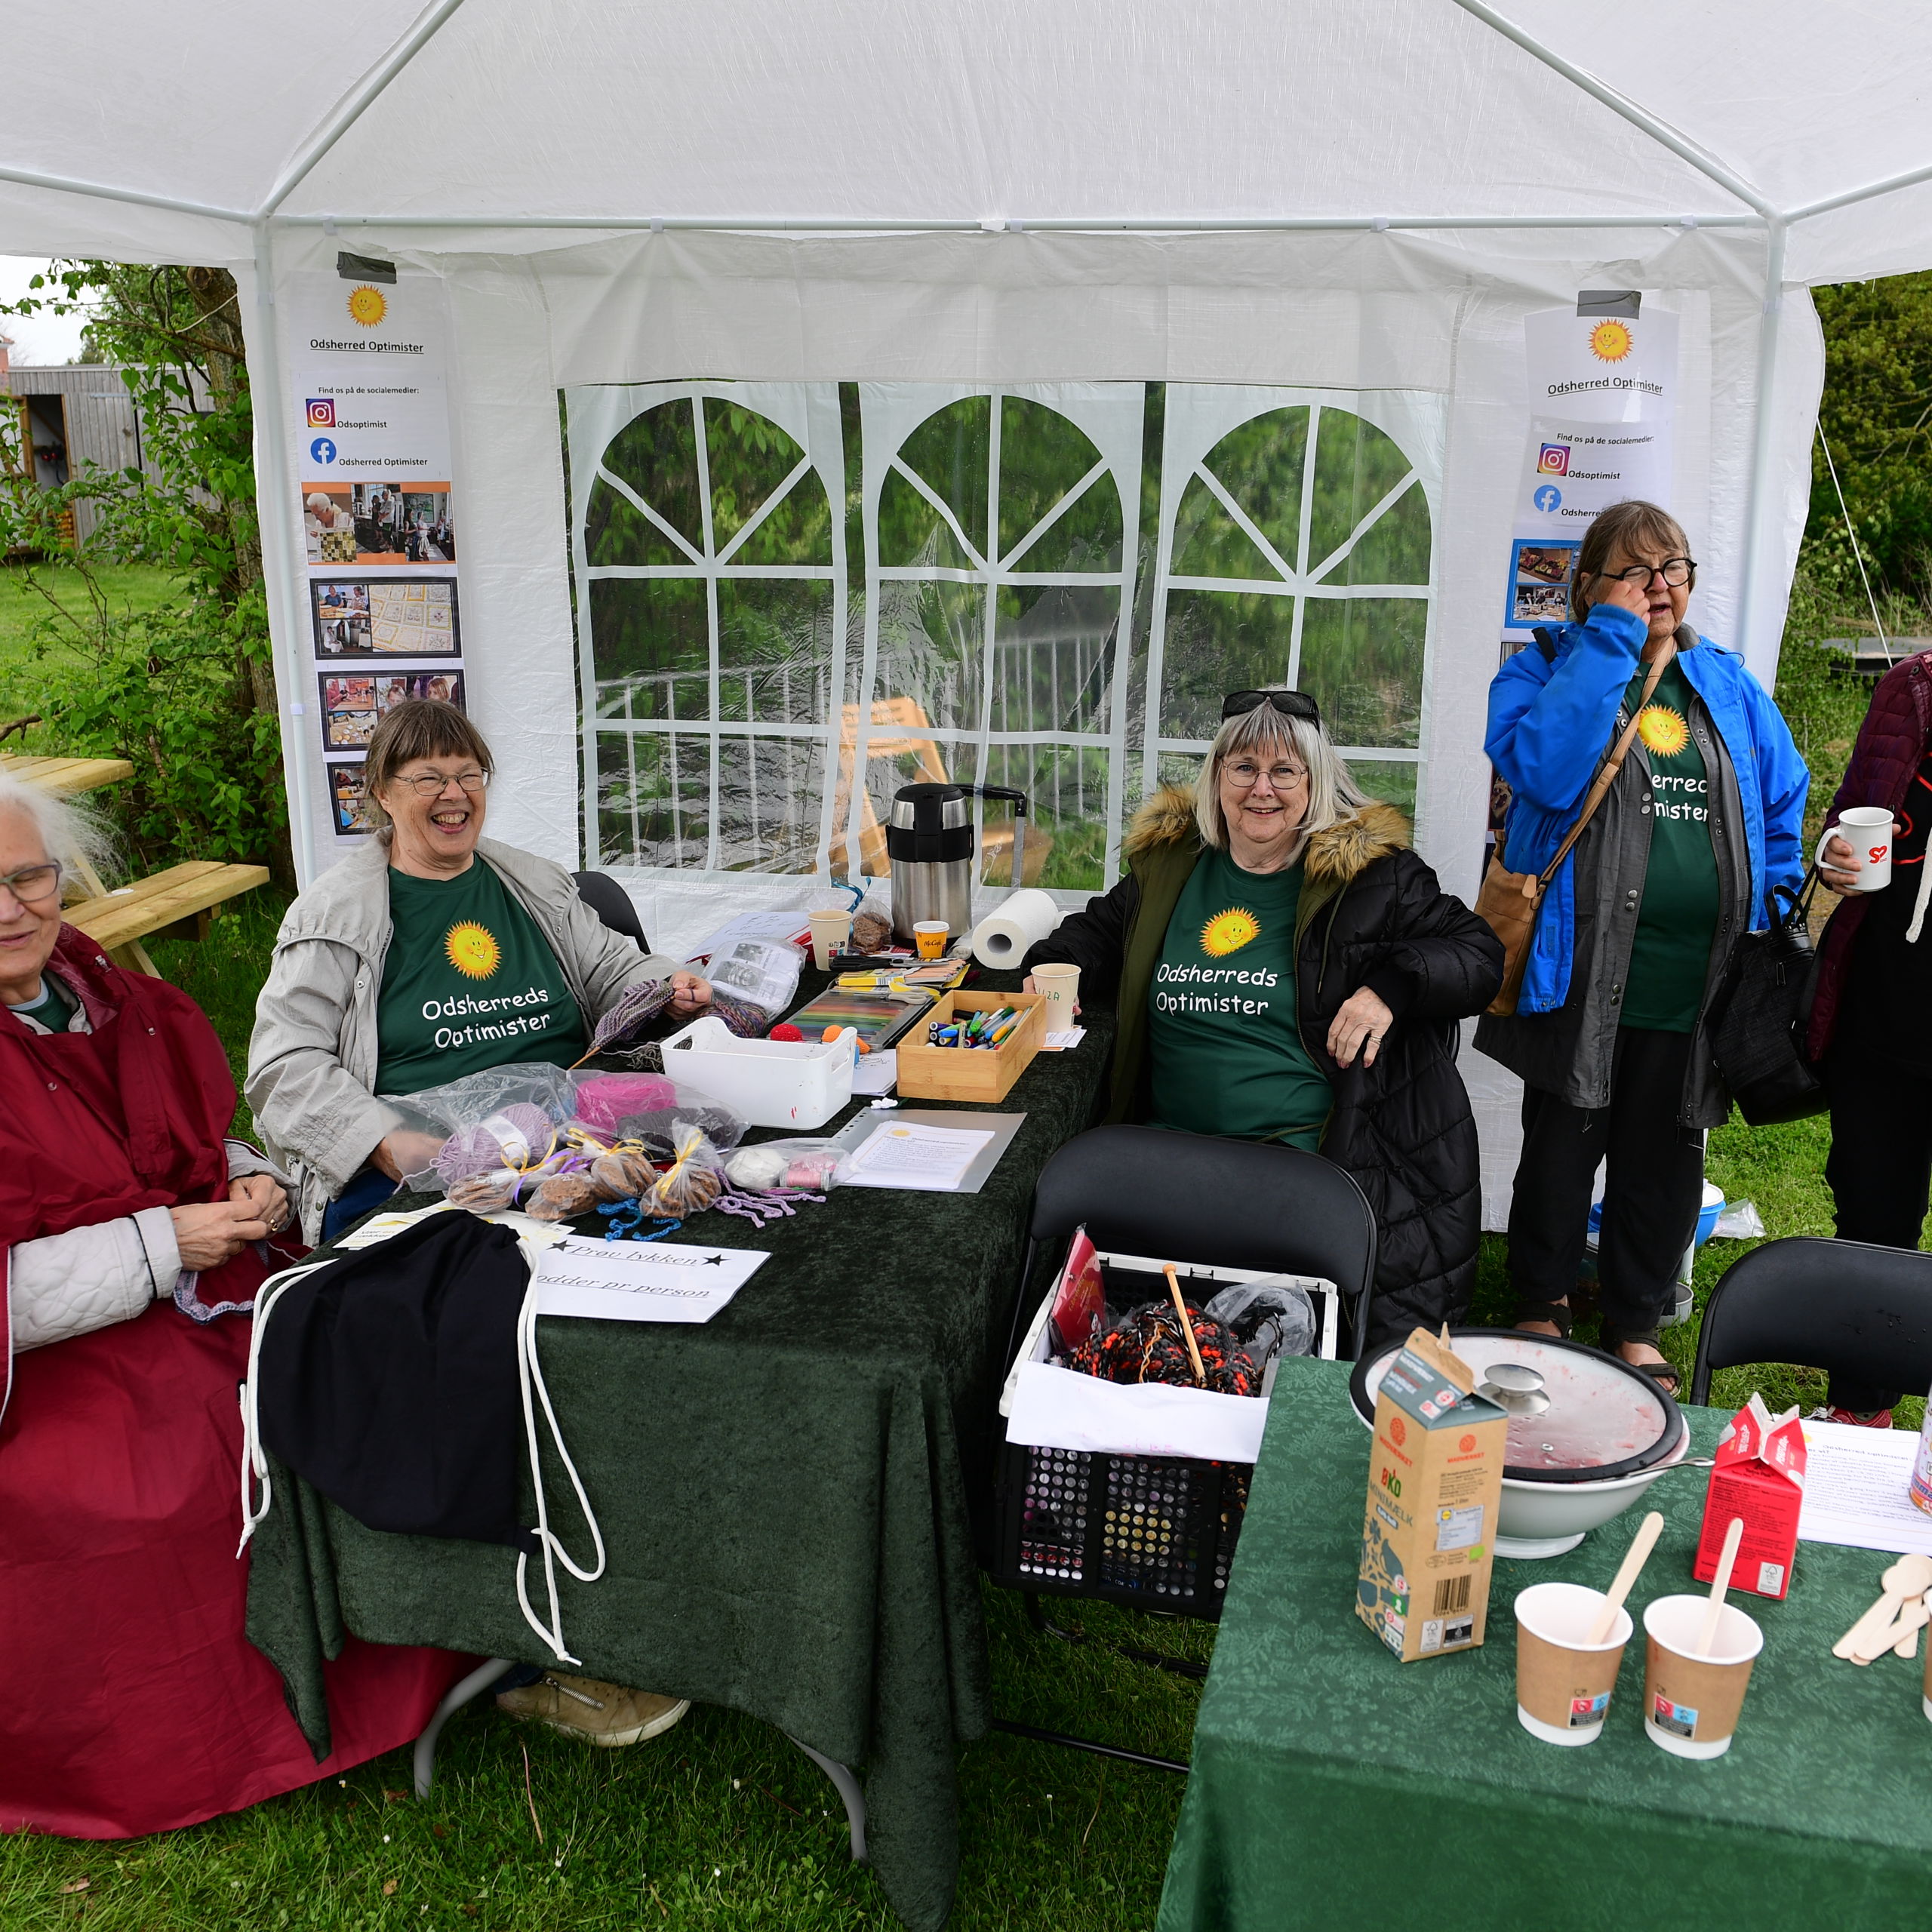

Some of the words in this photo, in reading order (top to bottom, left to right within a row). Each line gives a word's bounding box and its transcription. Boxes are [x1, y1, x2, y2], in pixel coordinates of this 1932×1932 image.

[310, 340, 365, 350] Odsherred
[368, 341, 423, 352] Optimister
[345, 386, 355, 395] på
[1548, 377, 1609, 395] Odsherred
[1613, 377, 1663, 394] Optimister
[337, 420, 387, 429] Odsoptimist
[1557, 433, 1573, 441] Find
[1585, 436, 1595, 445] på
[1607, 435, 1654, 445] socialemedier:
[383, 458, 428, 467] Optimister
[1568, 470, 1620, 481] Odsoptimist
[1561, 508, 1603, 517] Odsherre
[1157, 963, 1278, 987] Odsherreds
[422, 987, 549, 1020] Odsherreds
[1156, 992, 1269, 1016] Optimister
[435, 1014, 550, 1048] Optimister
[632, 1284, 710, 1297] person
